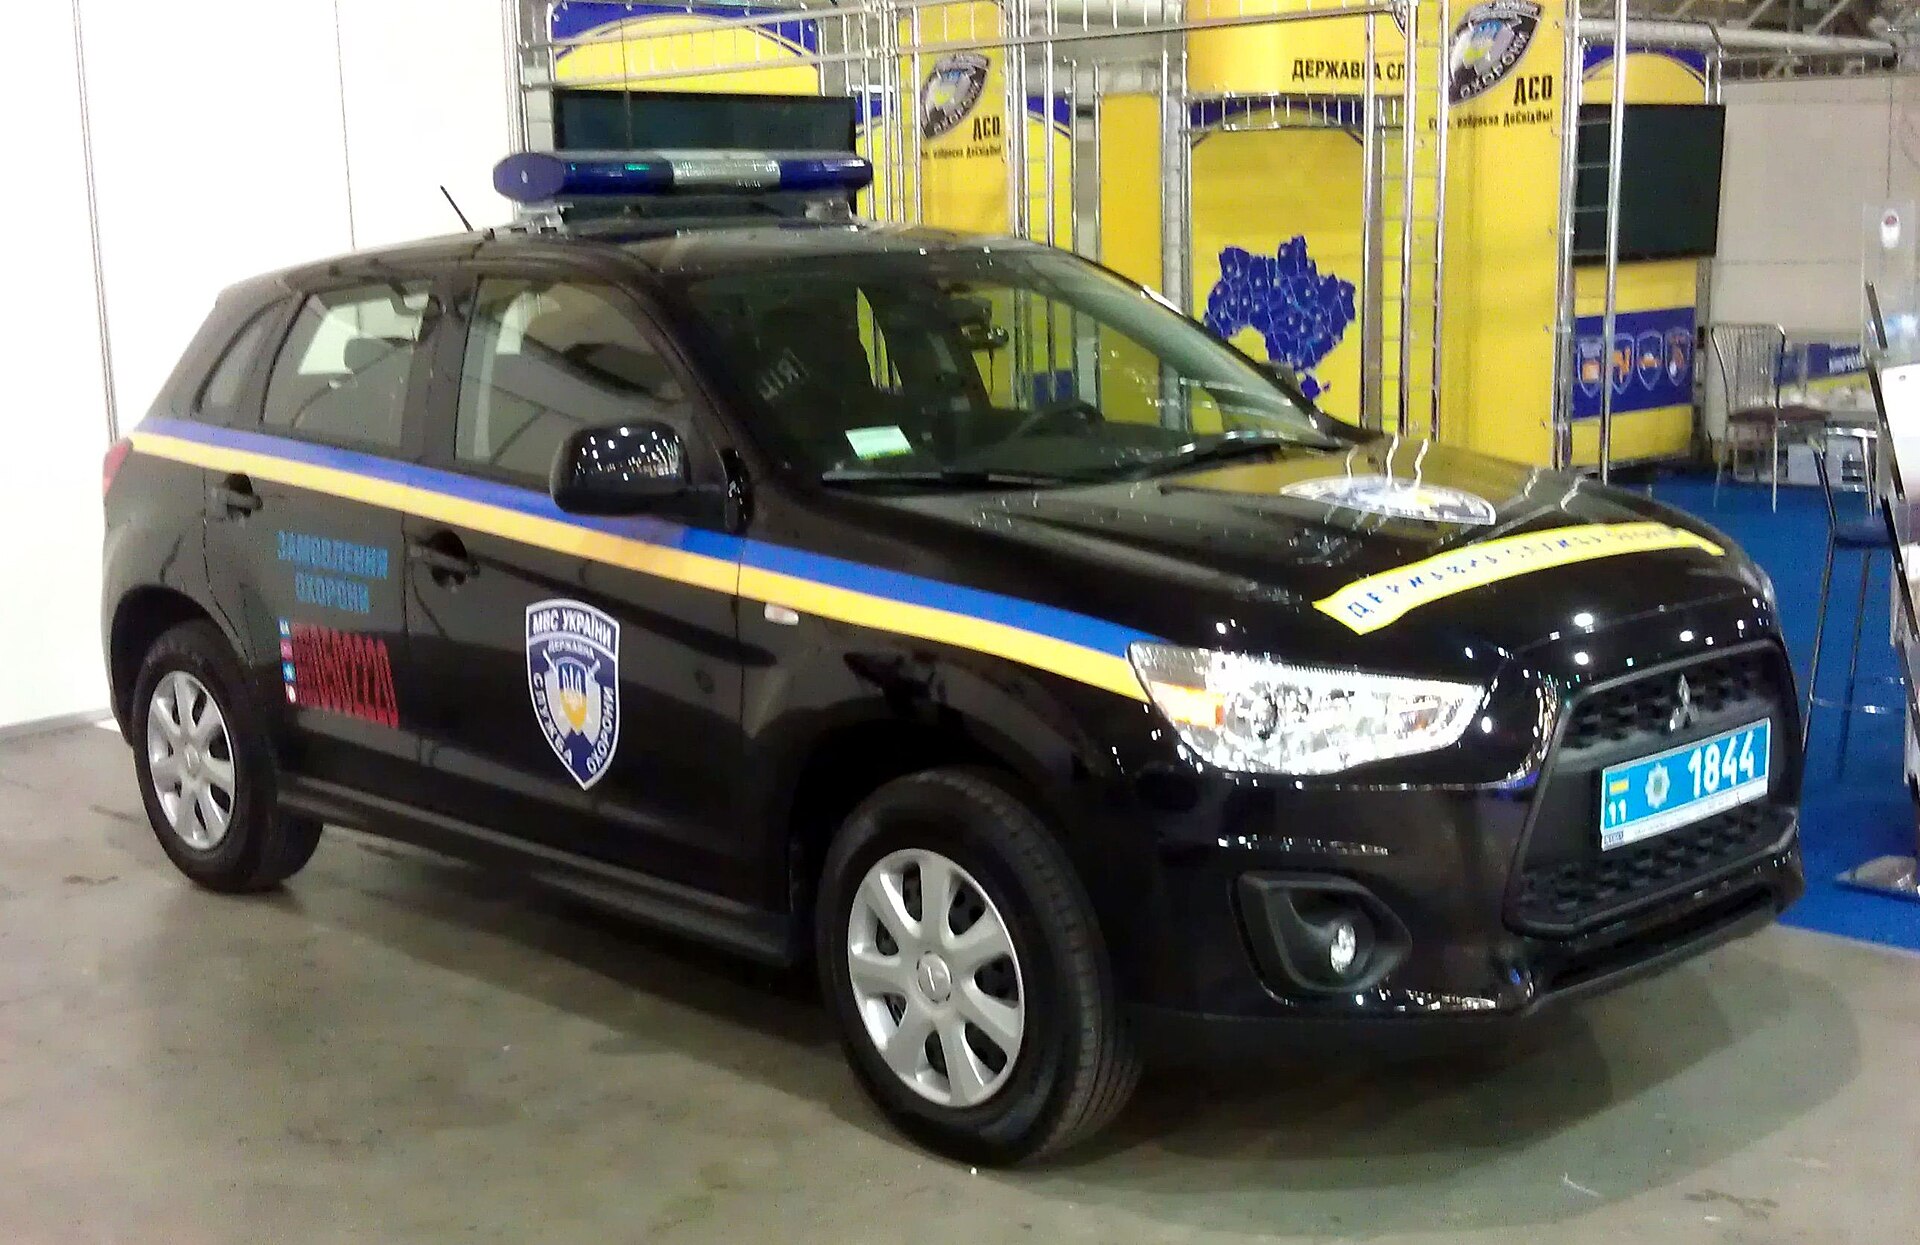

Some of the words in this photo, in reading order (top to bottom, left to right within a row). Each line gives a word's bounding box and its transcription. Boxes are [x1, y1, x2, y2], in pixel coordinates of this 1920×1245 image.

[1513, 75, 1553, 106] ДСО
[973, 116, 1000, 141] ДСО
[533, 608, 559, 635] МВС
[562, 608, 611, 651] УКРАЇНИ
[533, 672, 573, 767] СЛУЖБА
[586, 686, 615, 775] ОХОРОНИ
[1688, 730, 1755, 799] 1844
[1608, 799, 1627, 836] 11
